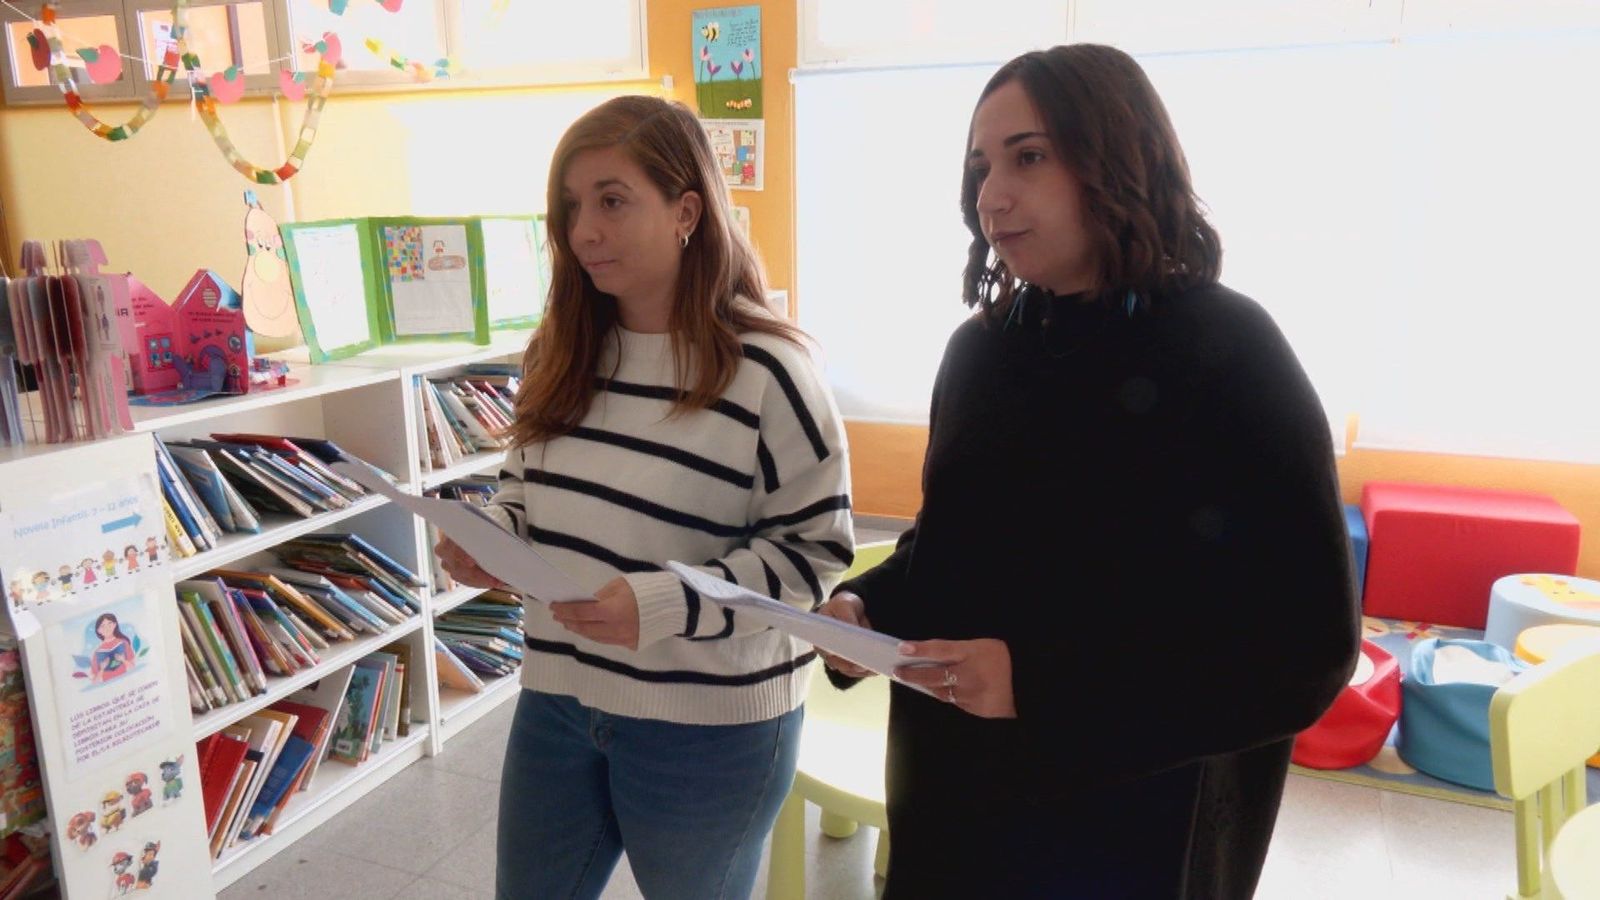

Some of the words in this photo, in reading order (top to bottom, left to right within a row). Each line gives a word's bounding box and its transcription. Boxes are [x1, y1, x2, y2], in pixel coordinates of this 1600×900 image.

[70, 711, 84, 722] LOS
[85, 701, 110, 716] LIBROS
[112, 694, 125, 705] QUE
[128, 689, 135, 697] SE
[113, 713, 123, 721] EN
[124, 708, 132, 716] LA
[72, 721, 81, 730] DE
[82, 718, 91, 726] LA
[74, 731, 99, 748] LIBROS
[101, 724, 117, 735] PARA
[77, 753, 90, 763] POR
